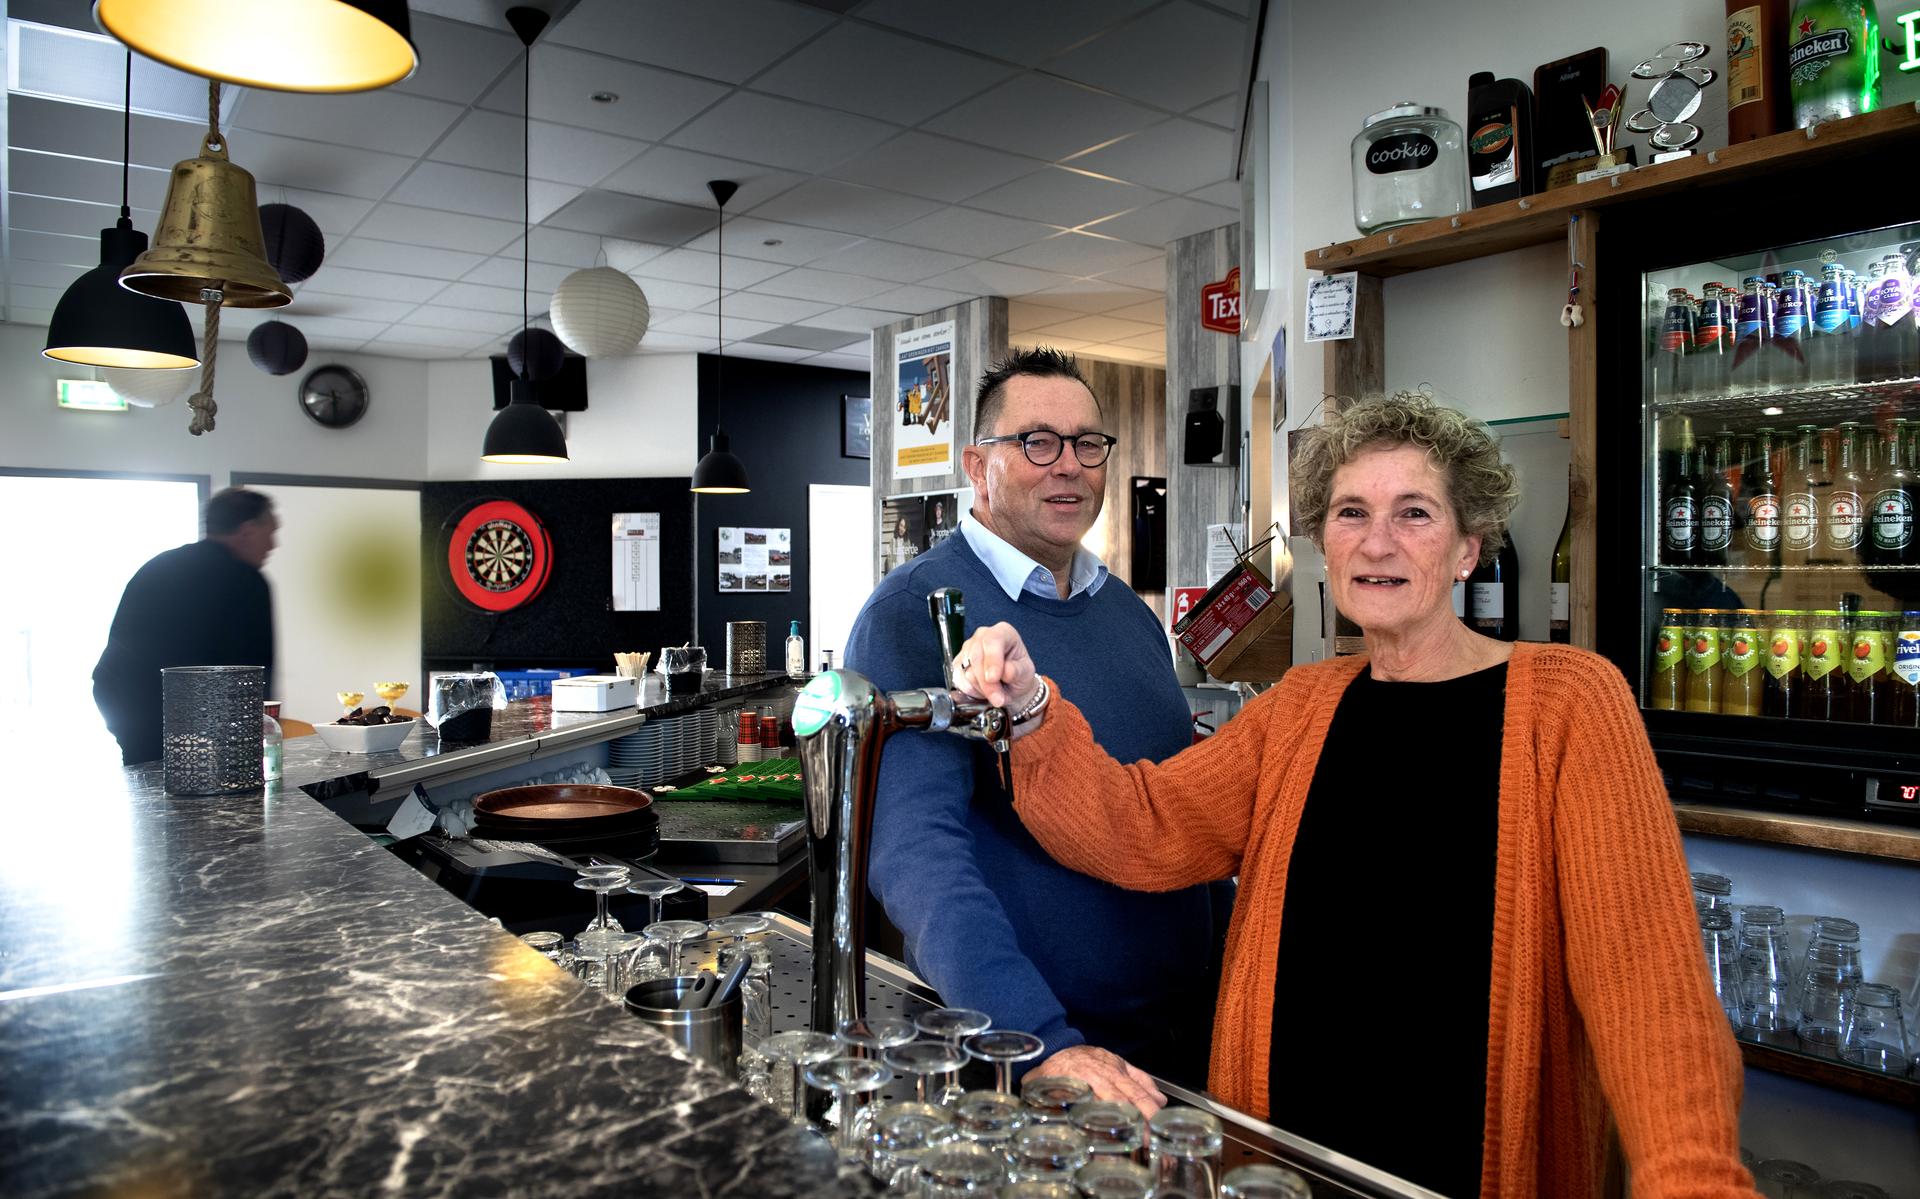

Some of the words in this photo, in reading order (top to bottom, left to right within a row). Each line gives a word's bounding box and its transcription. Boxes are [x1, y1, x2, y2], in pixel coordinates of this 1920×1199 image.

[1790, 37, 1842, 63] eineken
[1371, 141, 1431, 164] cookie
[1820, 295, 1845, 304] OURCY
[1208, 292, 1240, 320] TEX
[1780, 301, 1803, 310] OURCY
[1873, 514, 1912, 523] Heineken
[1896, 643, 1920, 654] rivel
